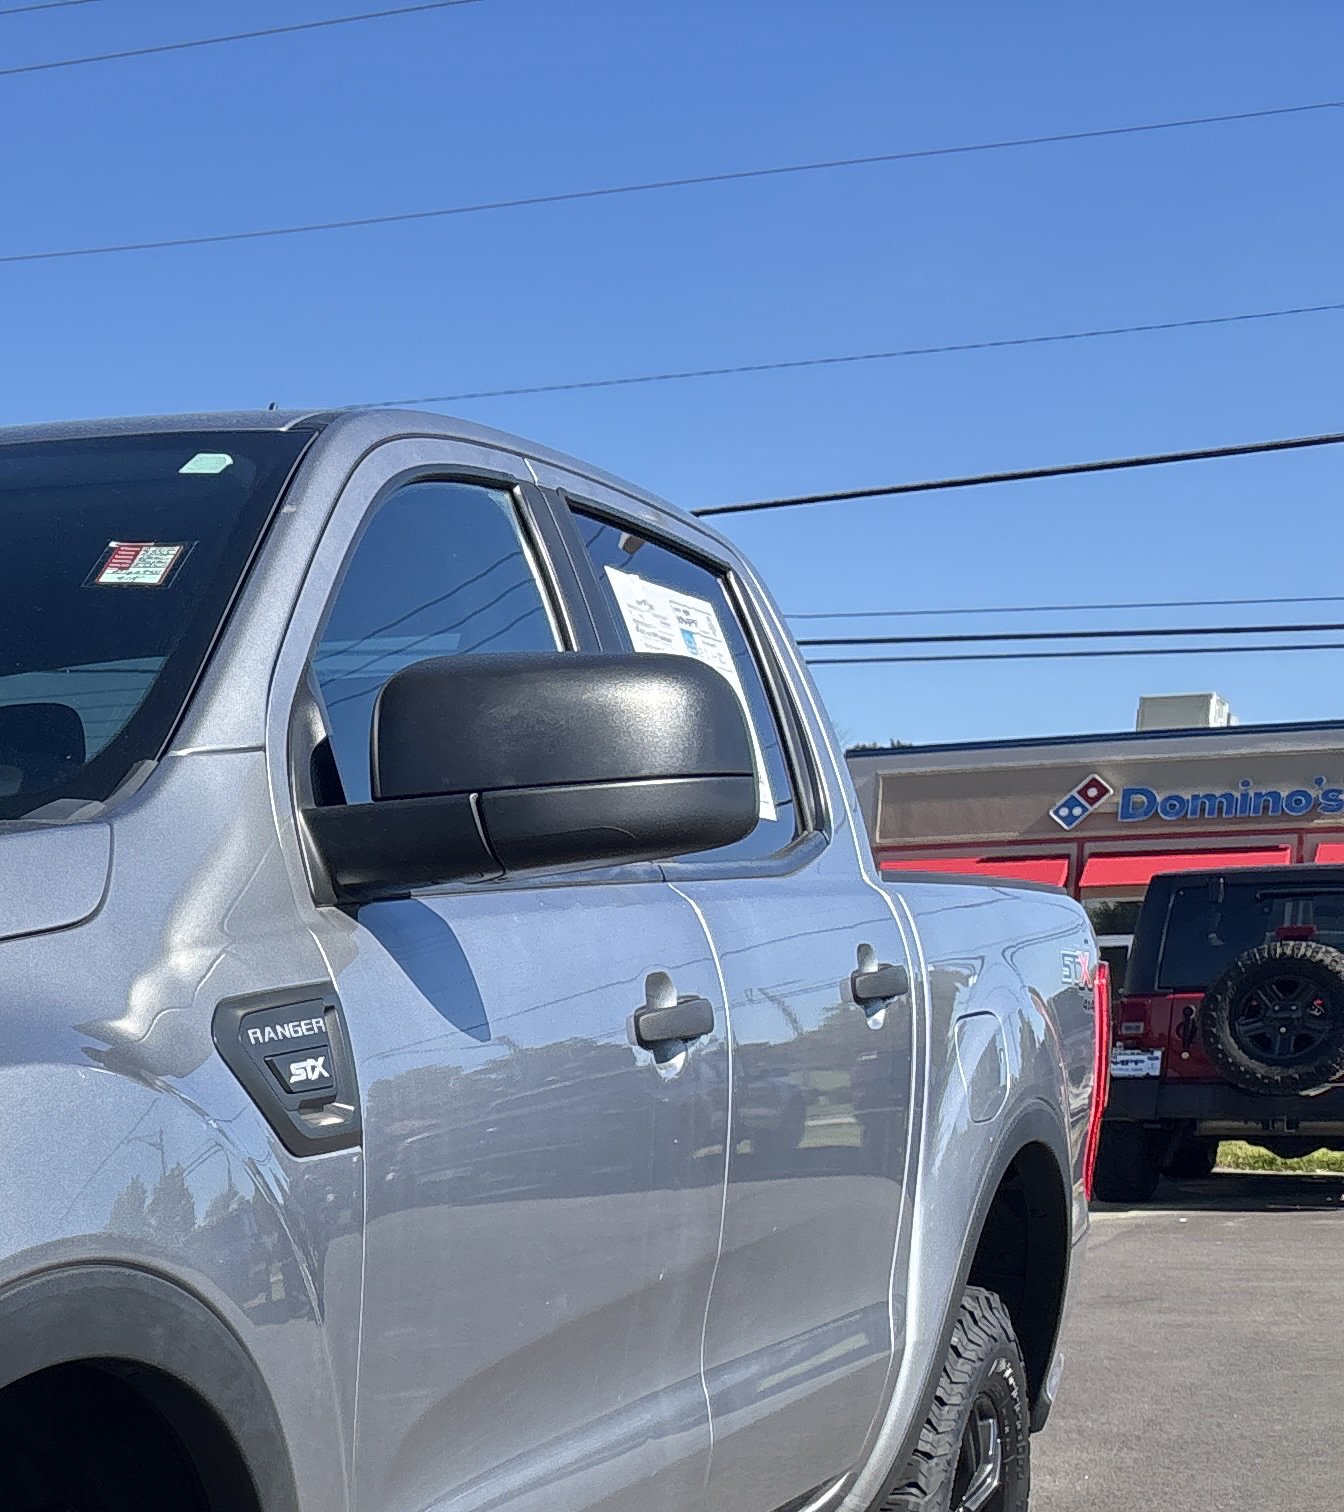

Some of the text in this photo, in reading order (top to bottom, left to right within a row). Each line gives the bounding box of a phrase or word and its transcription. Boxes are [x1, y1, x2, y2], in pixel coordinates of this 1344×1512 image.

[1118, 776, 1344, 822] Domino's
[247, 1017, 327, 1045] RANGER
[289, 1056, 330, 1084] STX
